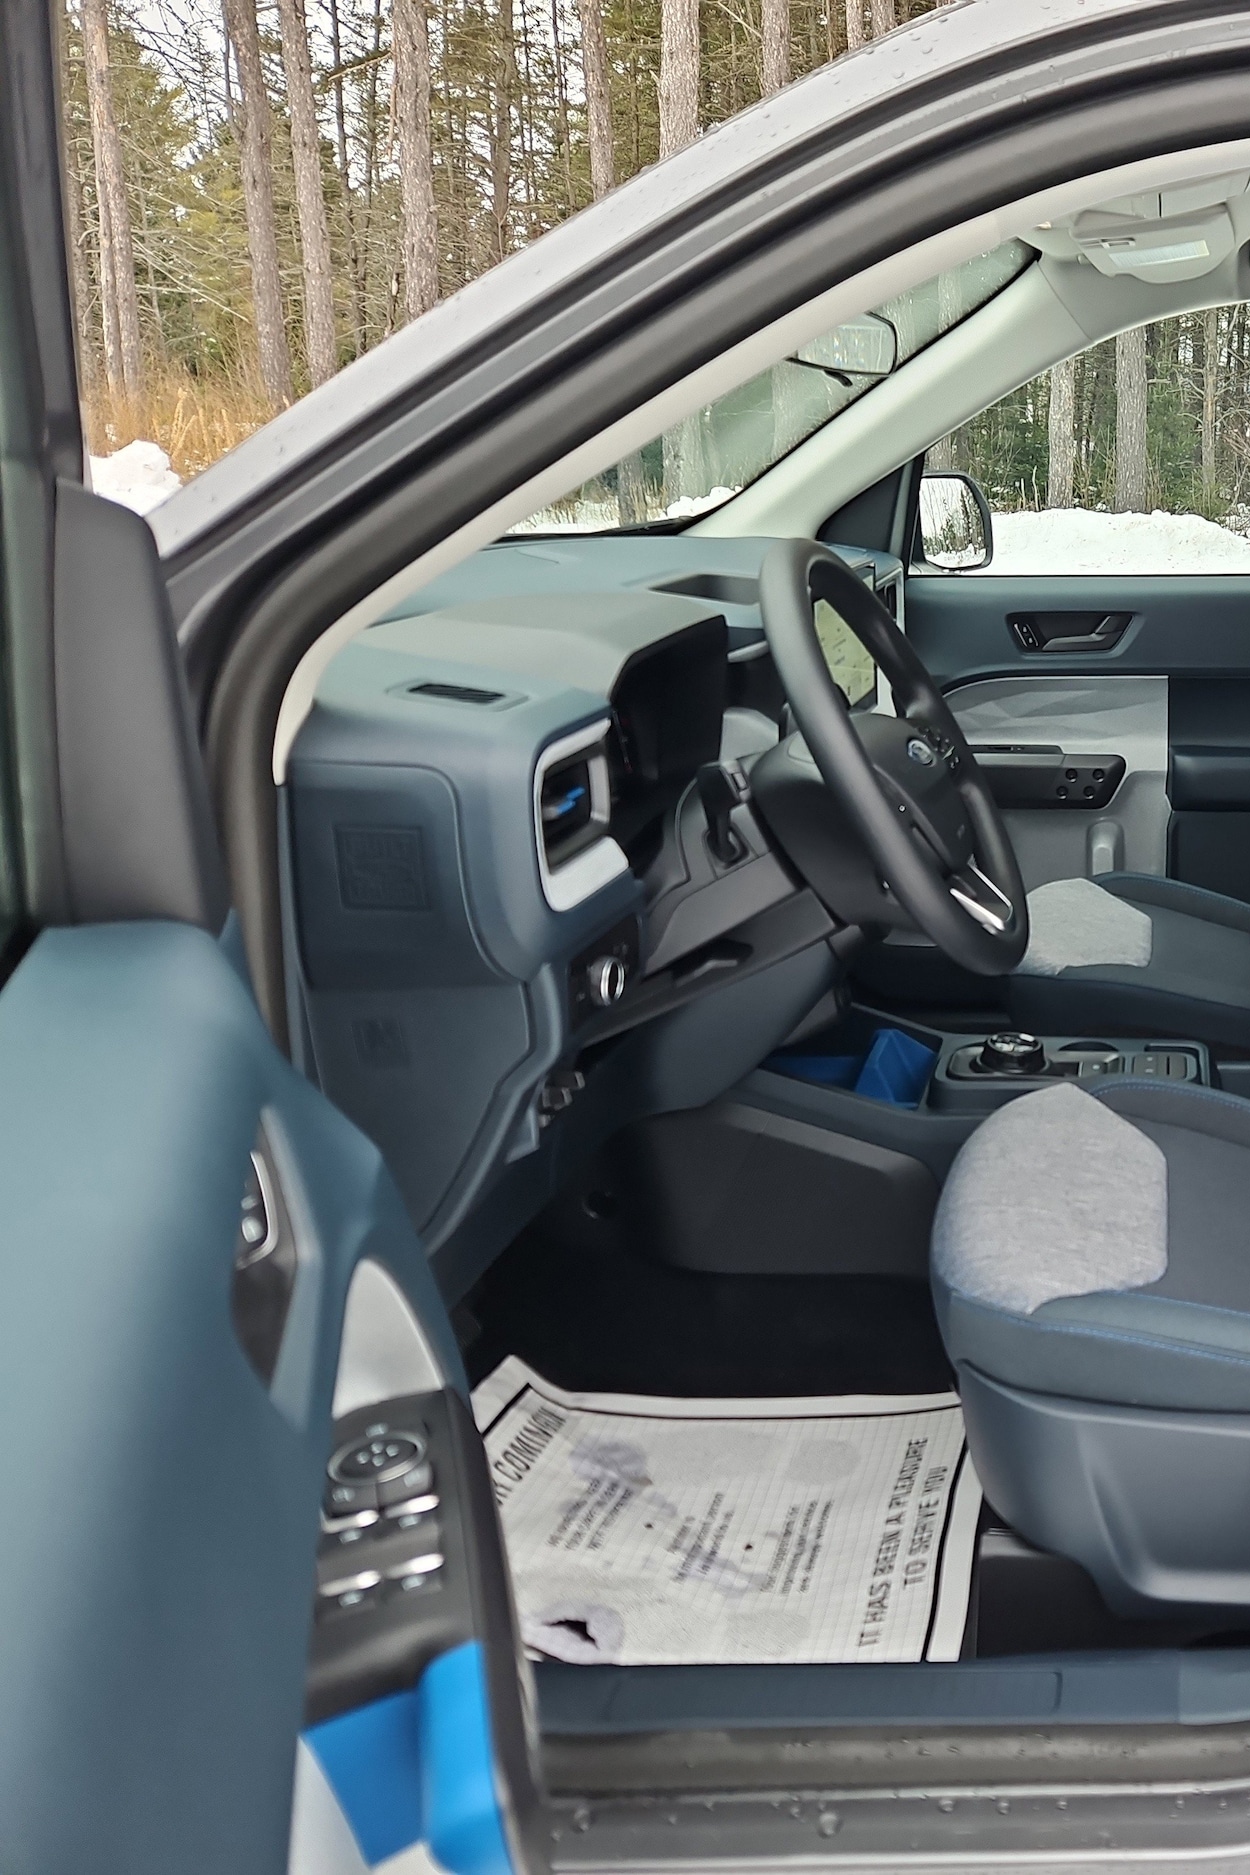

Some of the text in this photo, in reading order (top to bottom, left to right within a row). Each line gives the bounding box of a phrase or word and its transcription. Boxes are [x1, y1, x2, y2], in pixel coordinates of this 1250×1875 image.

[888, 1438, 928, 1508] PLEASURE
[885, 1511, 906, 1527] A
[903, 1466, 948, 1588] TO SERVE YOU
[873, 1530, 903, 1576] BEEN
[864, 1584, 891, 1623] HAS
